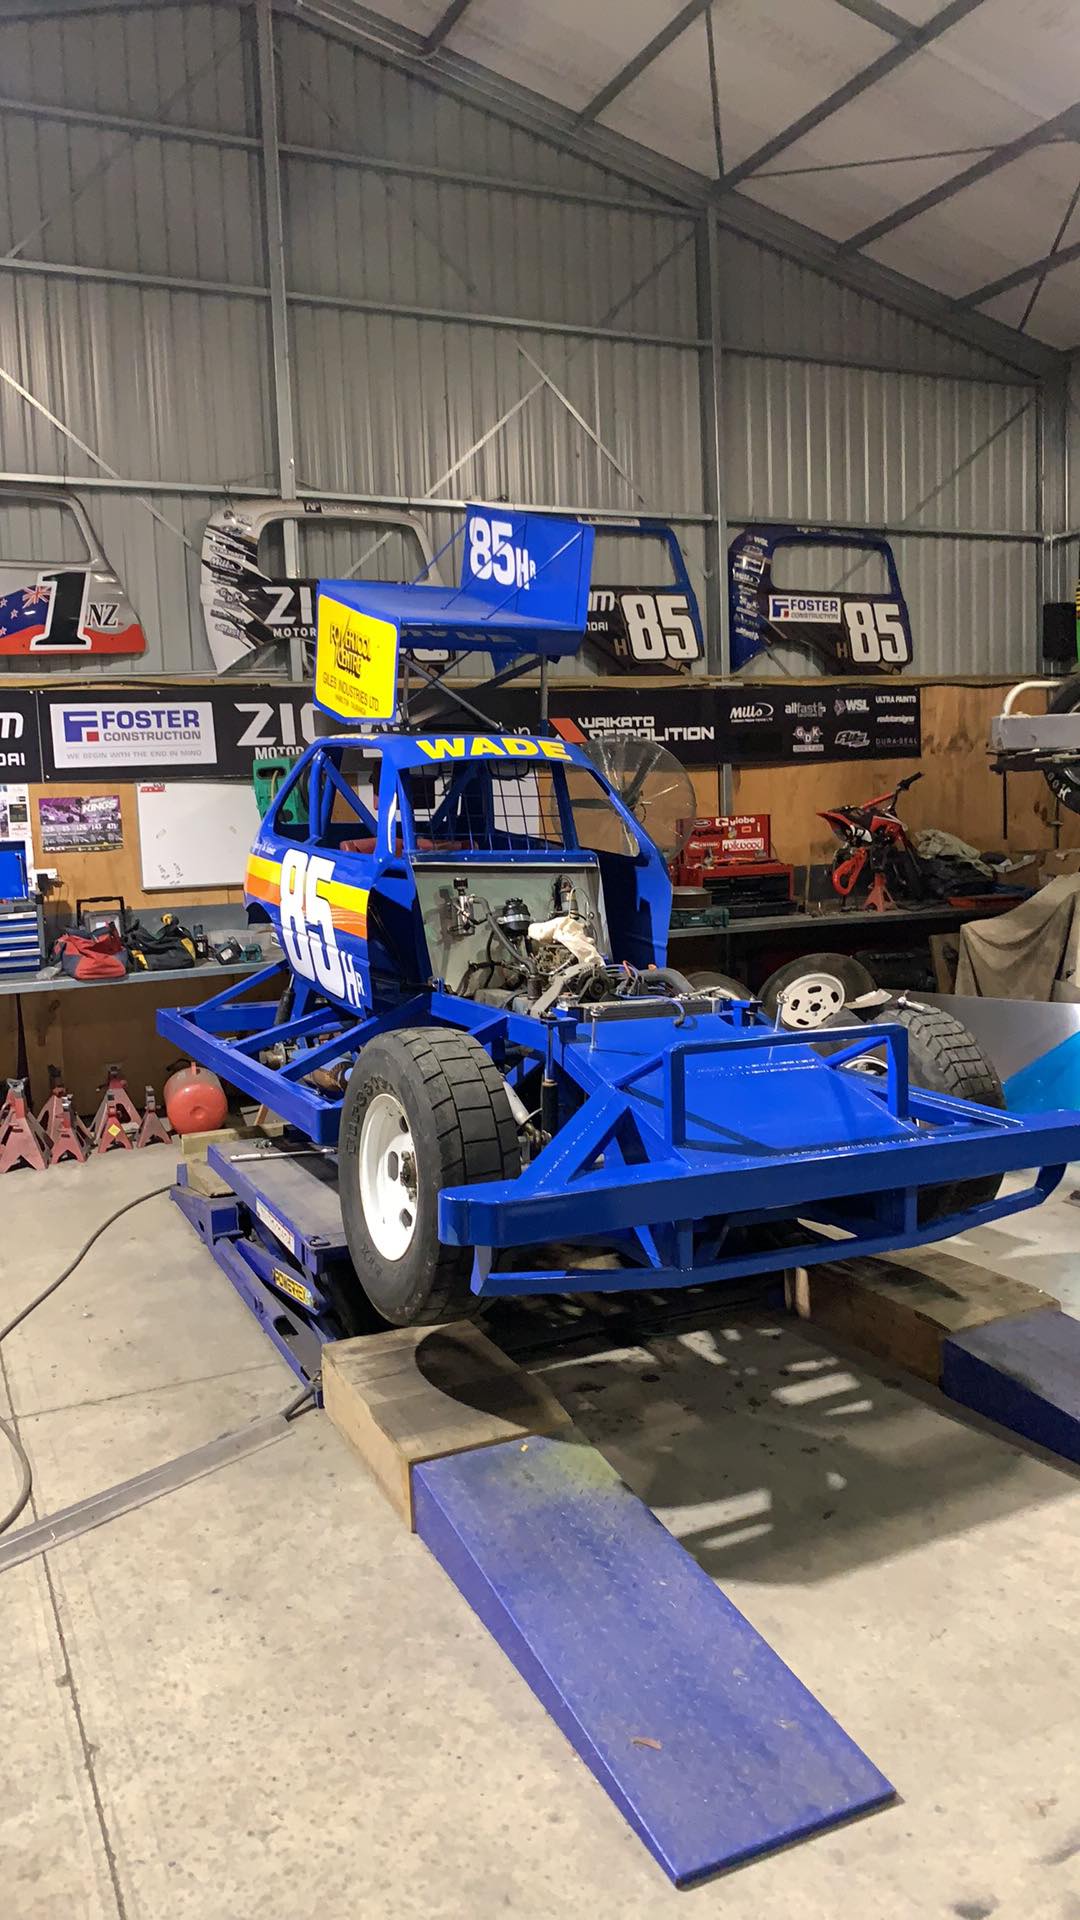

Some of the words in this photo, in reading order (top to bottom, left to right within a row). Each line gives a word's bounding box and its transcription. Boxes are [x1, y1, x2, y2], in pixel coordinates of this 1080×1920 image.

[34, 571, 88, 646] 1
[88, 603, 119, 626] NZ
[790, 599, 838, 612] FOSTER
[791, 612, 839, 620] CONSTRUCTION
[620, 594, 699, 660] 85
[843, 602, 908, 662] 85
[845, 699, 868, 711] WSL
[875, 695, 895, 704] ULTRA
[895, 695, 917, 704] PAINTS
[101, 710, 200, 730] FOSTER
[578, 716, 655, 728] WAIKATO
[103, 731, 201, 742] CONSTRUCTION
[415, 736, 573, 761] WADE
